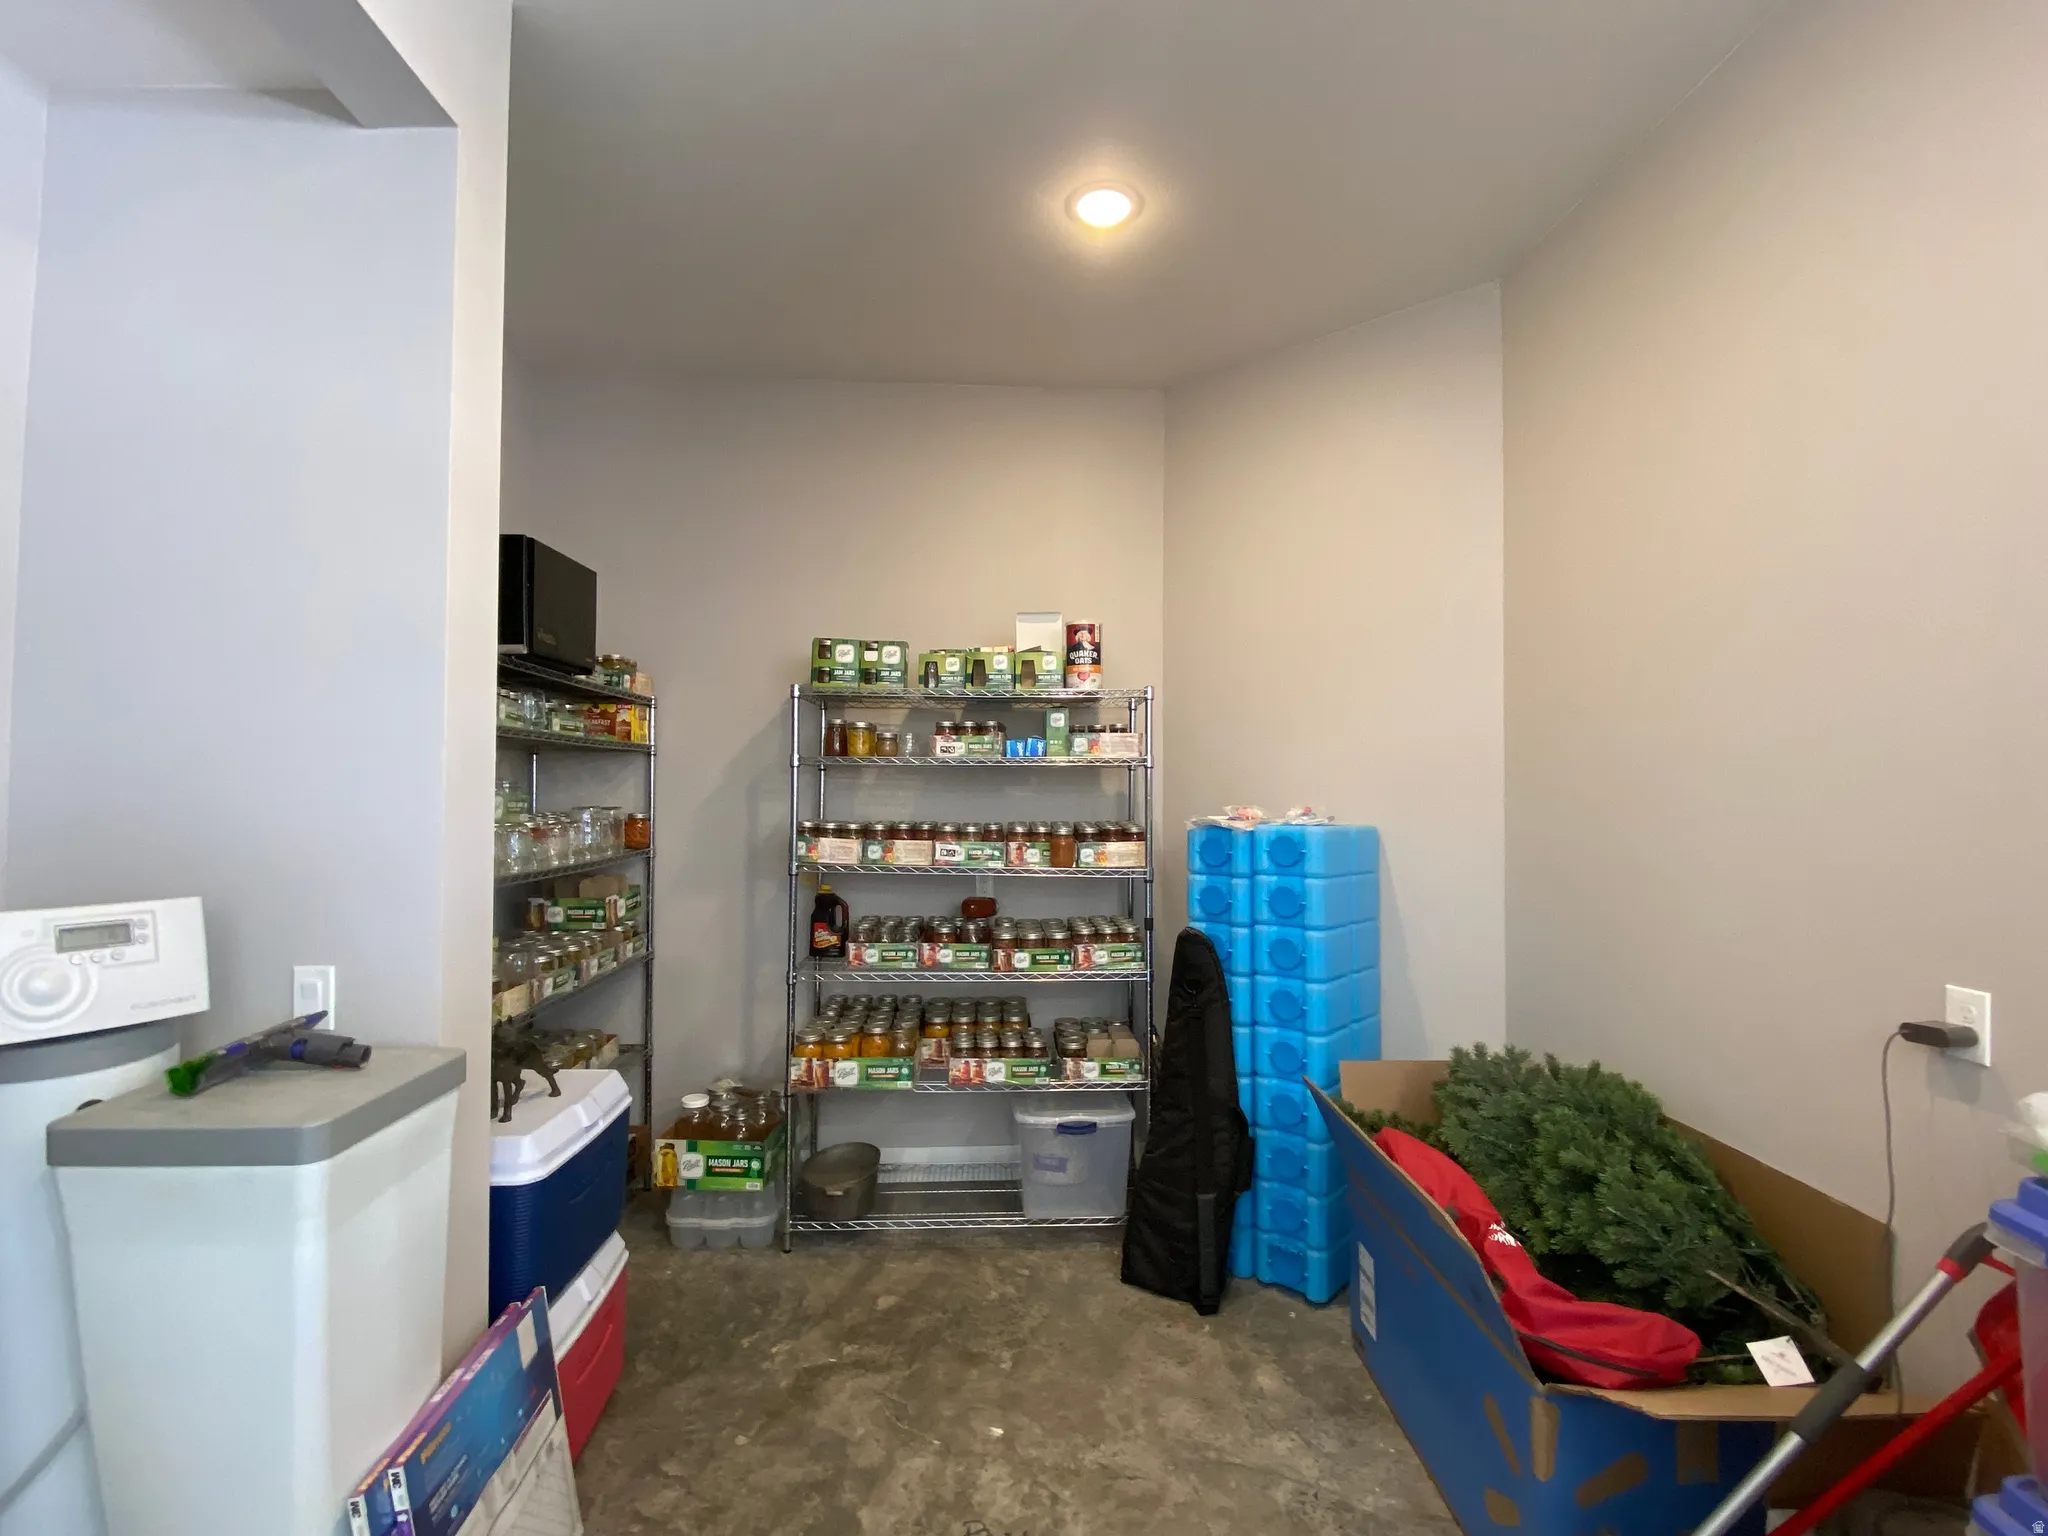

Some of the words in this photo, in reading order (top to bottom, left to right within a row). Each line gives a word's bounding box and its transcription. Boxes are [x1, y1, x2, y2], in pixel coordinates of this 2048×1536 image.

[837, 649, 852, 659] Ball
[884, 650, 898, 659] Ball
[1069, 650, 1098, 660] QUAKER
[837, 1066, 856, 1080] Ball
[682, 1158, 701, 1172] Ball
[708, 1159, 731, 1167] MASON
[732, 1158, 748, 1168] JARS
[391, 1471, 402, 1489] 3M
[350, 1501, 361, 1518] 3M
